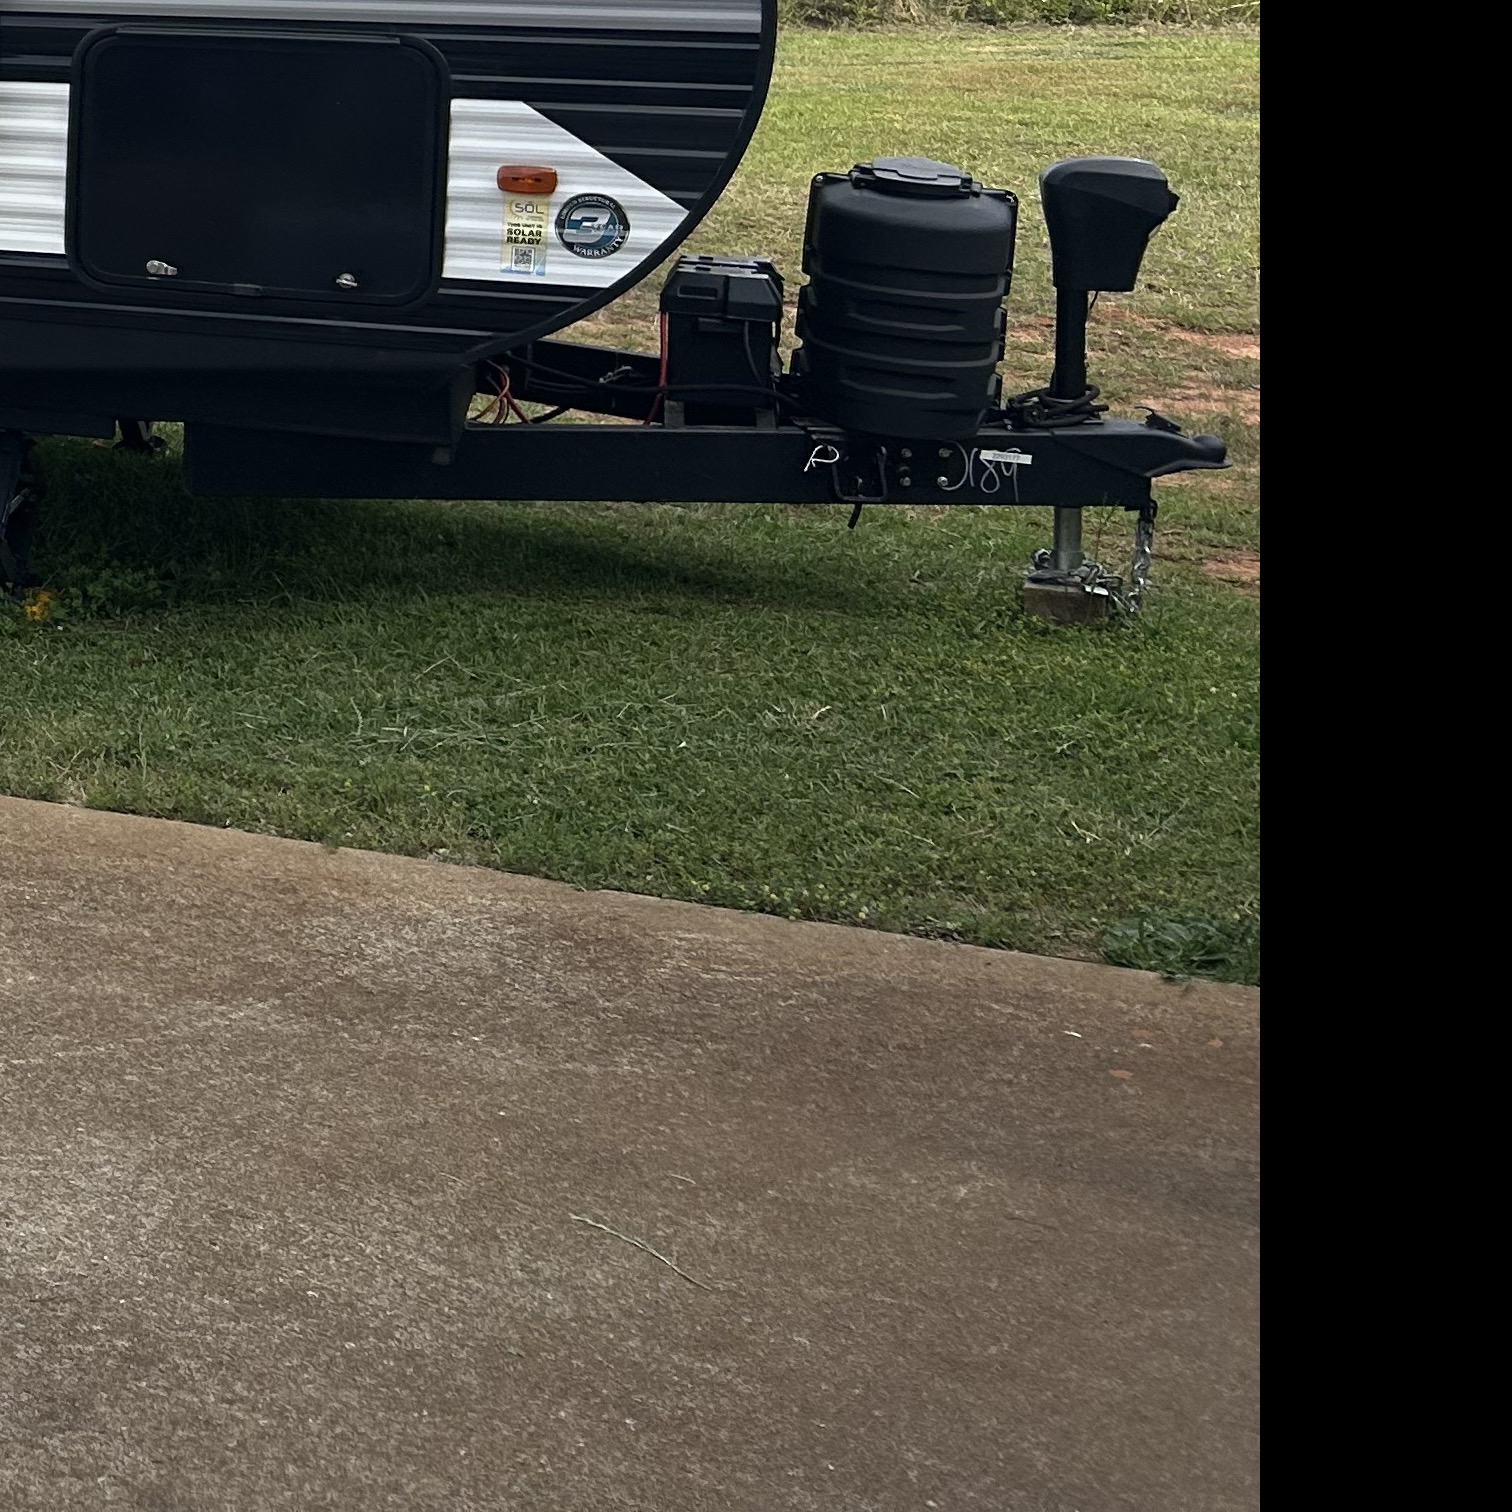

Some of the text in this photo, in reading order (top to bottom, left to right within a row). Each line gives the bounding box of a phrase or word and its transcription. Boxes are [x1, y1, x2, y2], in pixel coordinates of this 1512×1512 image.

[563, 207, 611, 243] 3
[506, 228, 543, 238] SOLAR
[506, 236, 542, 245] READY
[573, 236, 624, 257] WARRANTY
